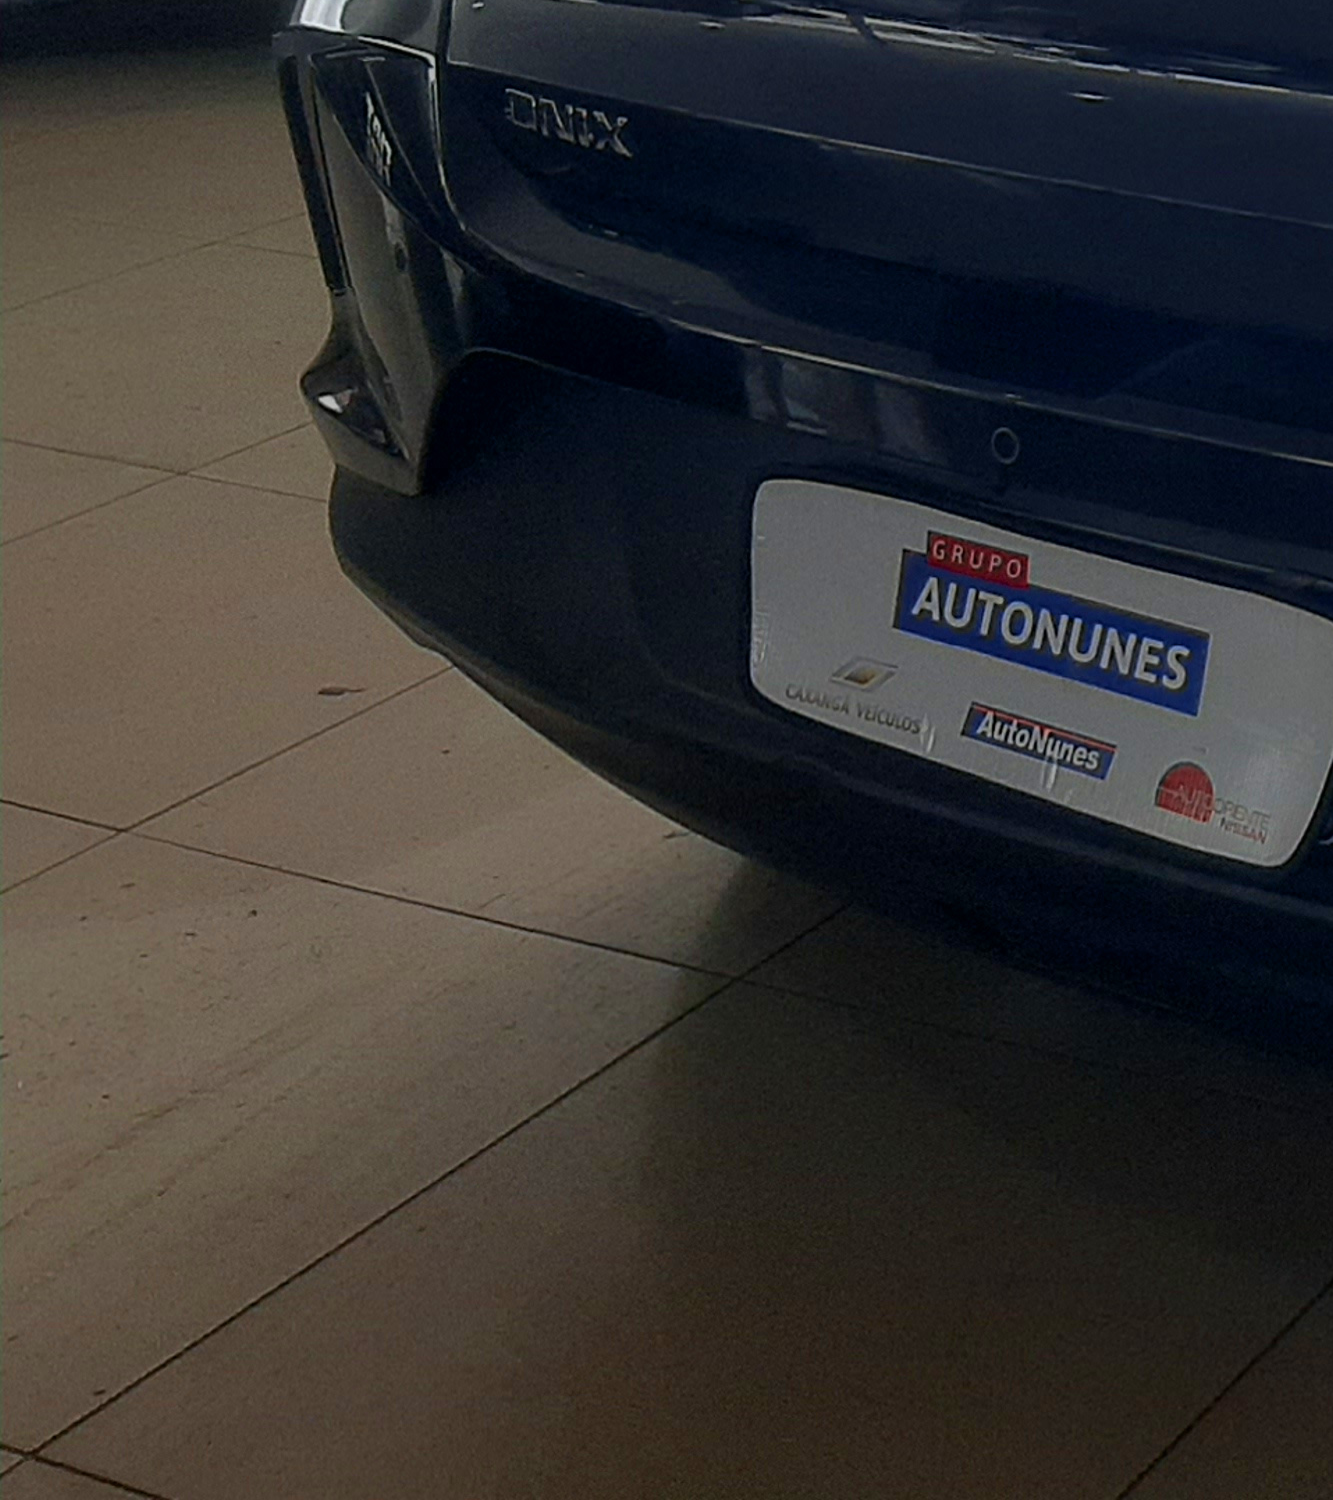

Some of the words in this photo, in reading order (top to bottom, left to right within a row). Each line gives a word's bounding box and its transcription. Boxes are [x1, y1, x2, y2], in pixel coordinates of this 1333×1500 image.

[504, 87, 633, 158] ONIX
[932, 539, 1023, 579] GRUPO
[911, 576, 1191, 690] AUTONUNES
[976, 710, 1101, 771] AutoNunes
